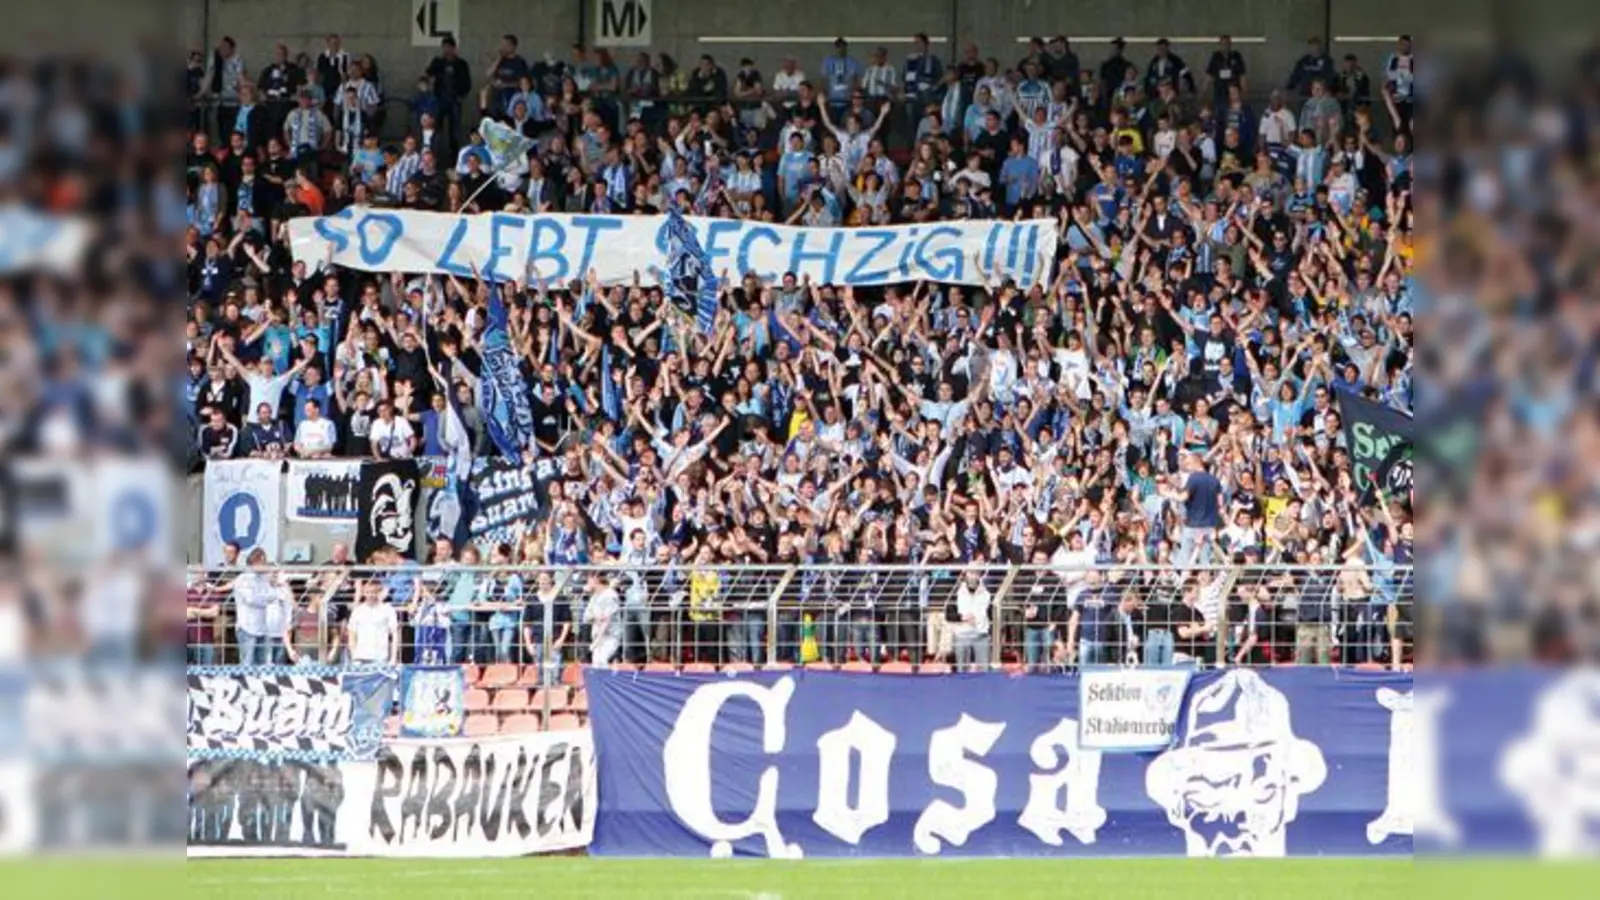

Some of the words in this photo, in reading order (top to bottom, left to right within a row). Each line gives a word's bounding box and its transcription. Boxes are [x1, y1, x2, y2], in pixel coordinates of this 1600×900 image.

[429, 1, 453, 38] L
[601, 1, 636, 38] M
[313, 208, 404, 266] SO
[436, 215, 624, 290] LEBT
[368, 741, 586, 846] RABAUKEN
[663, 674, 1107, 859] Cosa
